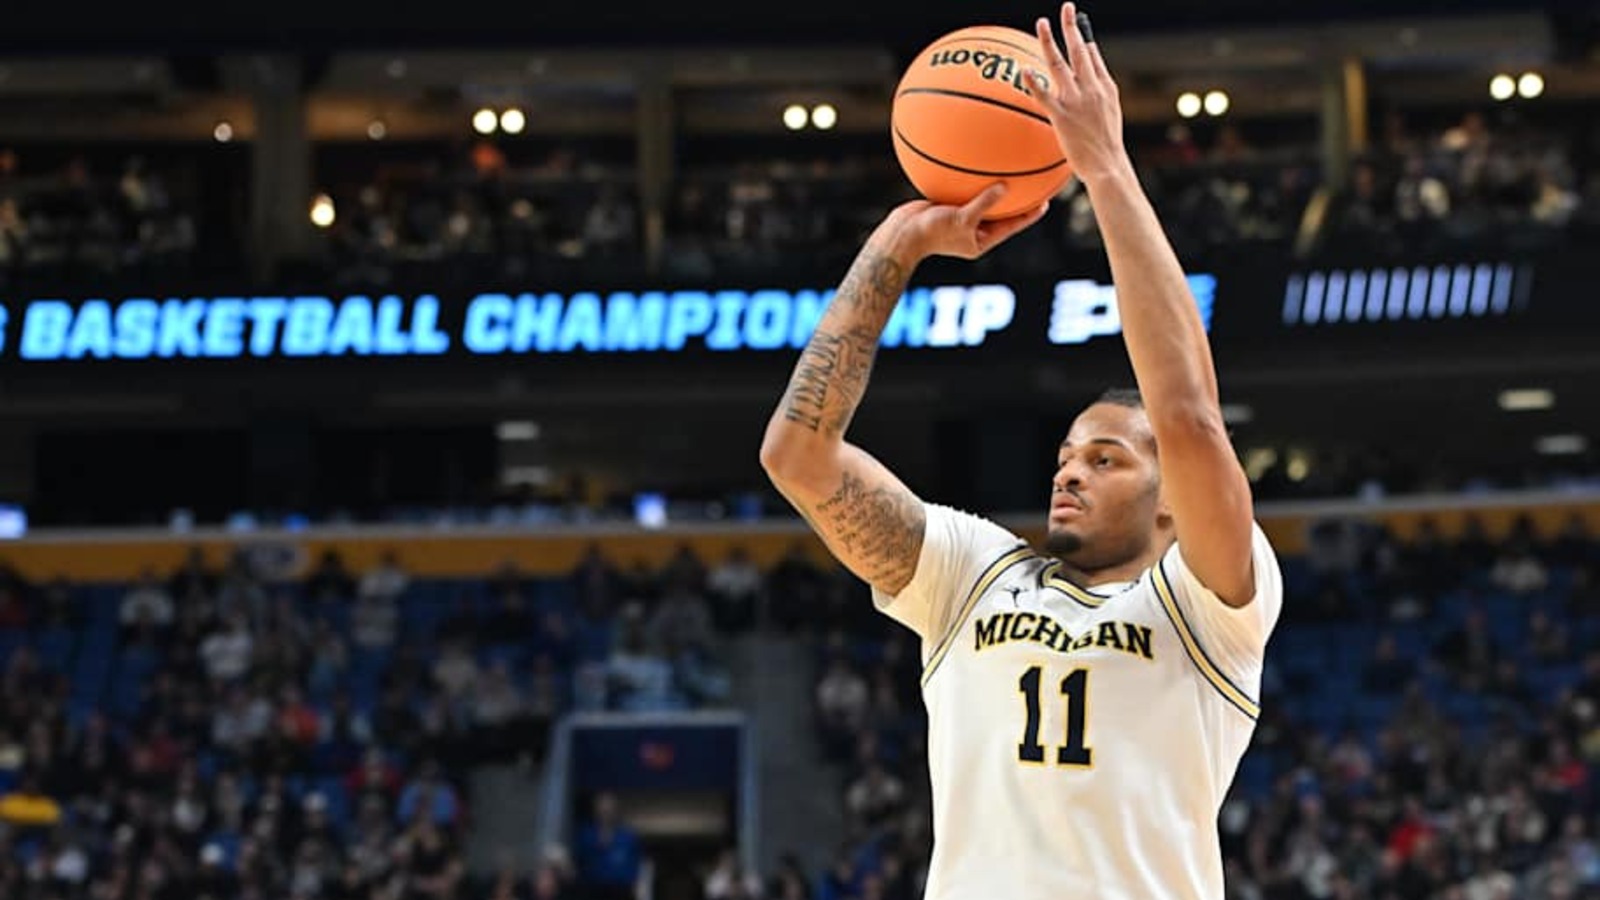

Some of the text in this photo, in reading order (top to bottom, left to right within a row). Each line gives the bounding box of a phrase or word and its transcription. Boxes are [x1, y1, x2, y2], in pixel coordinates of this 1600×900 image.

[20, 296, 449, 358] BASKETBALL
[464, 286, 1015, 353] CHAMPIONHIP
[975, 612, 1153, 659] MICHIGAN
[1017, 664, 1094, 770] 11
